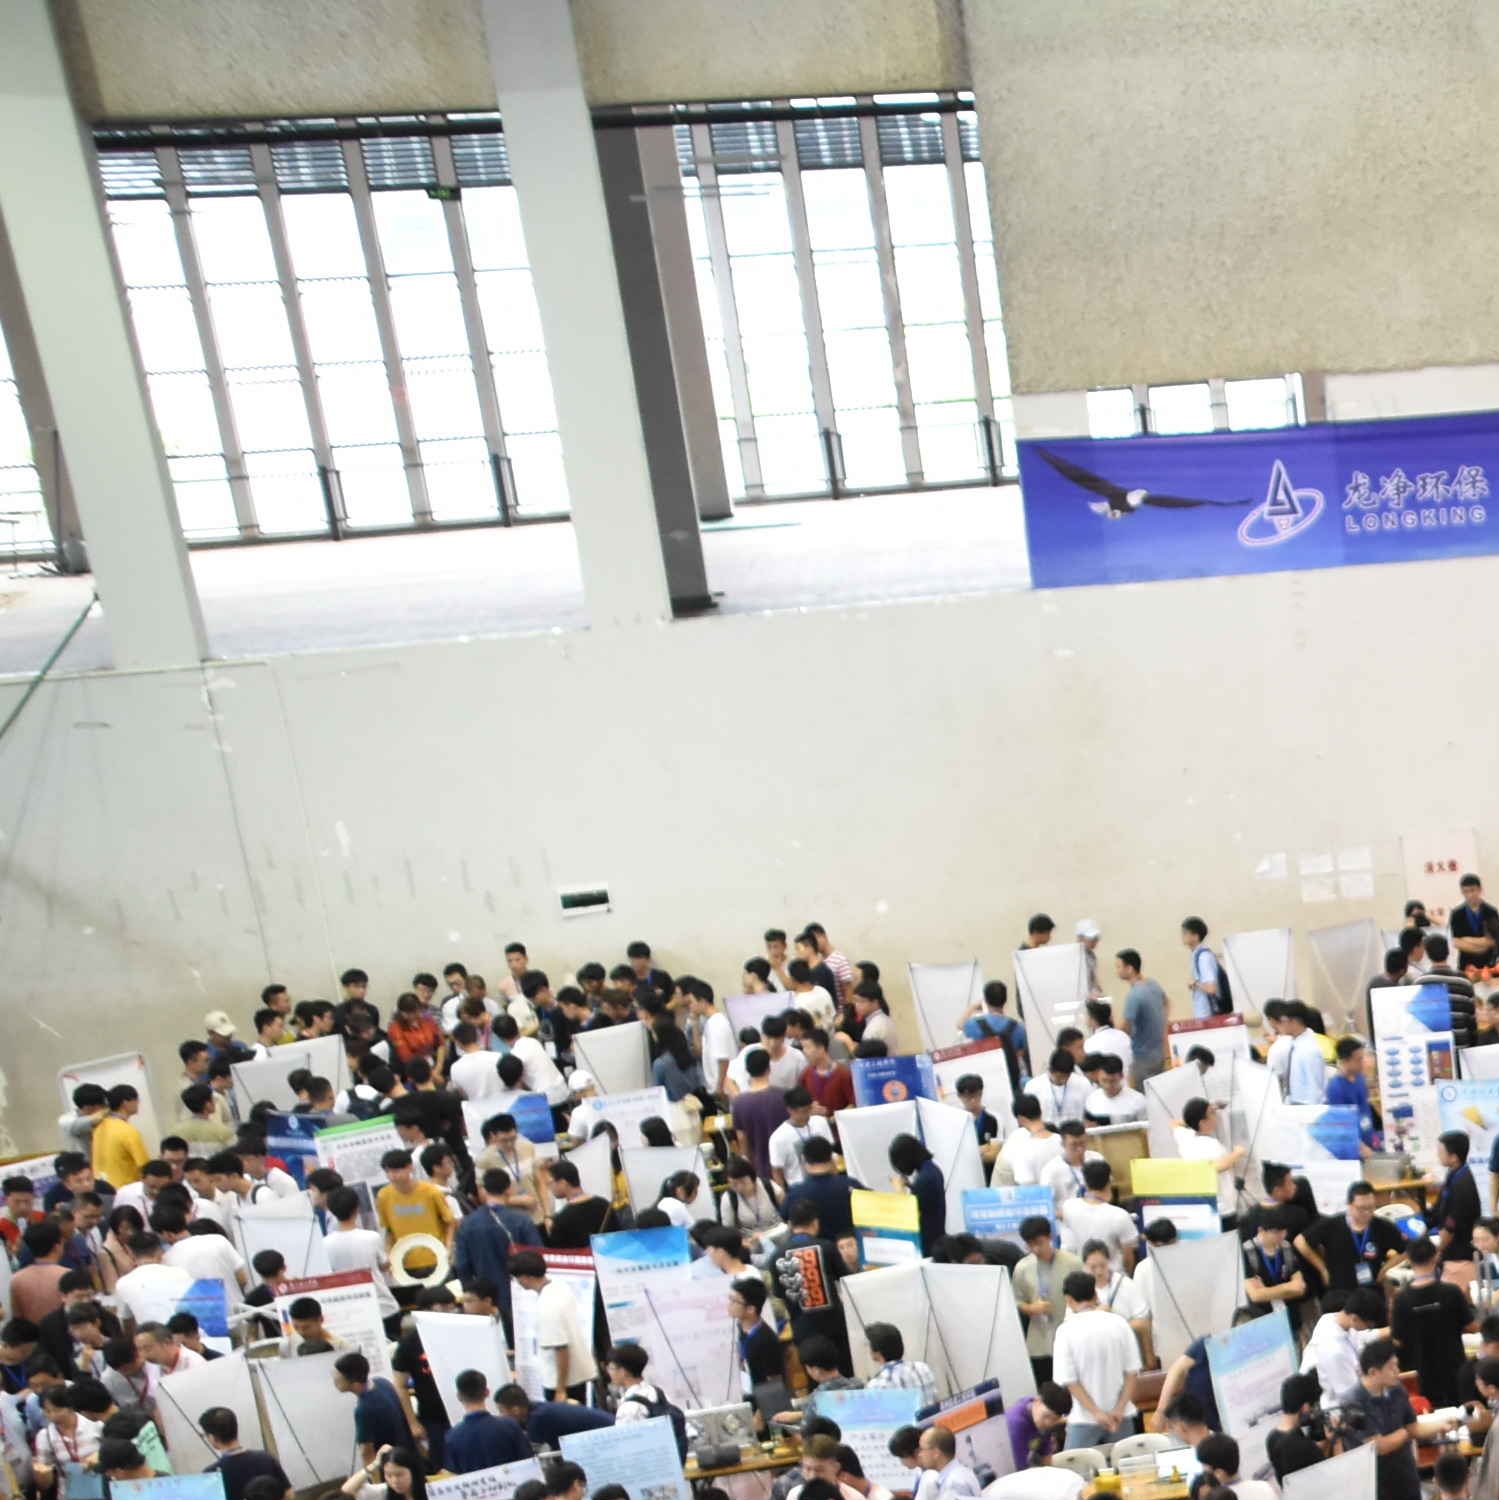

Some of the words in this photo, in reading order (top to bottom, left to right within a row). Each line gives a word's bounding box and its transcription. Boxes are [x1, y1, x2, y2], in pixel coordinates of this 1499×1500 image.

[1343, 464, 1491, 511] 龙净环保
[1345, 504, 1488, 533] LONGKING
